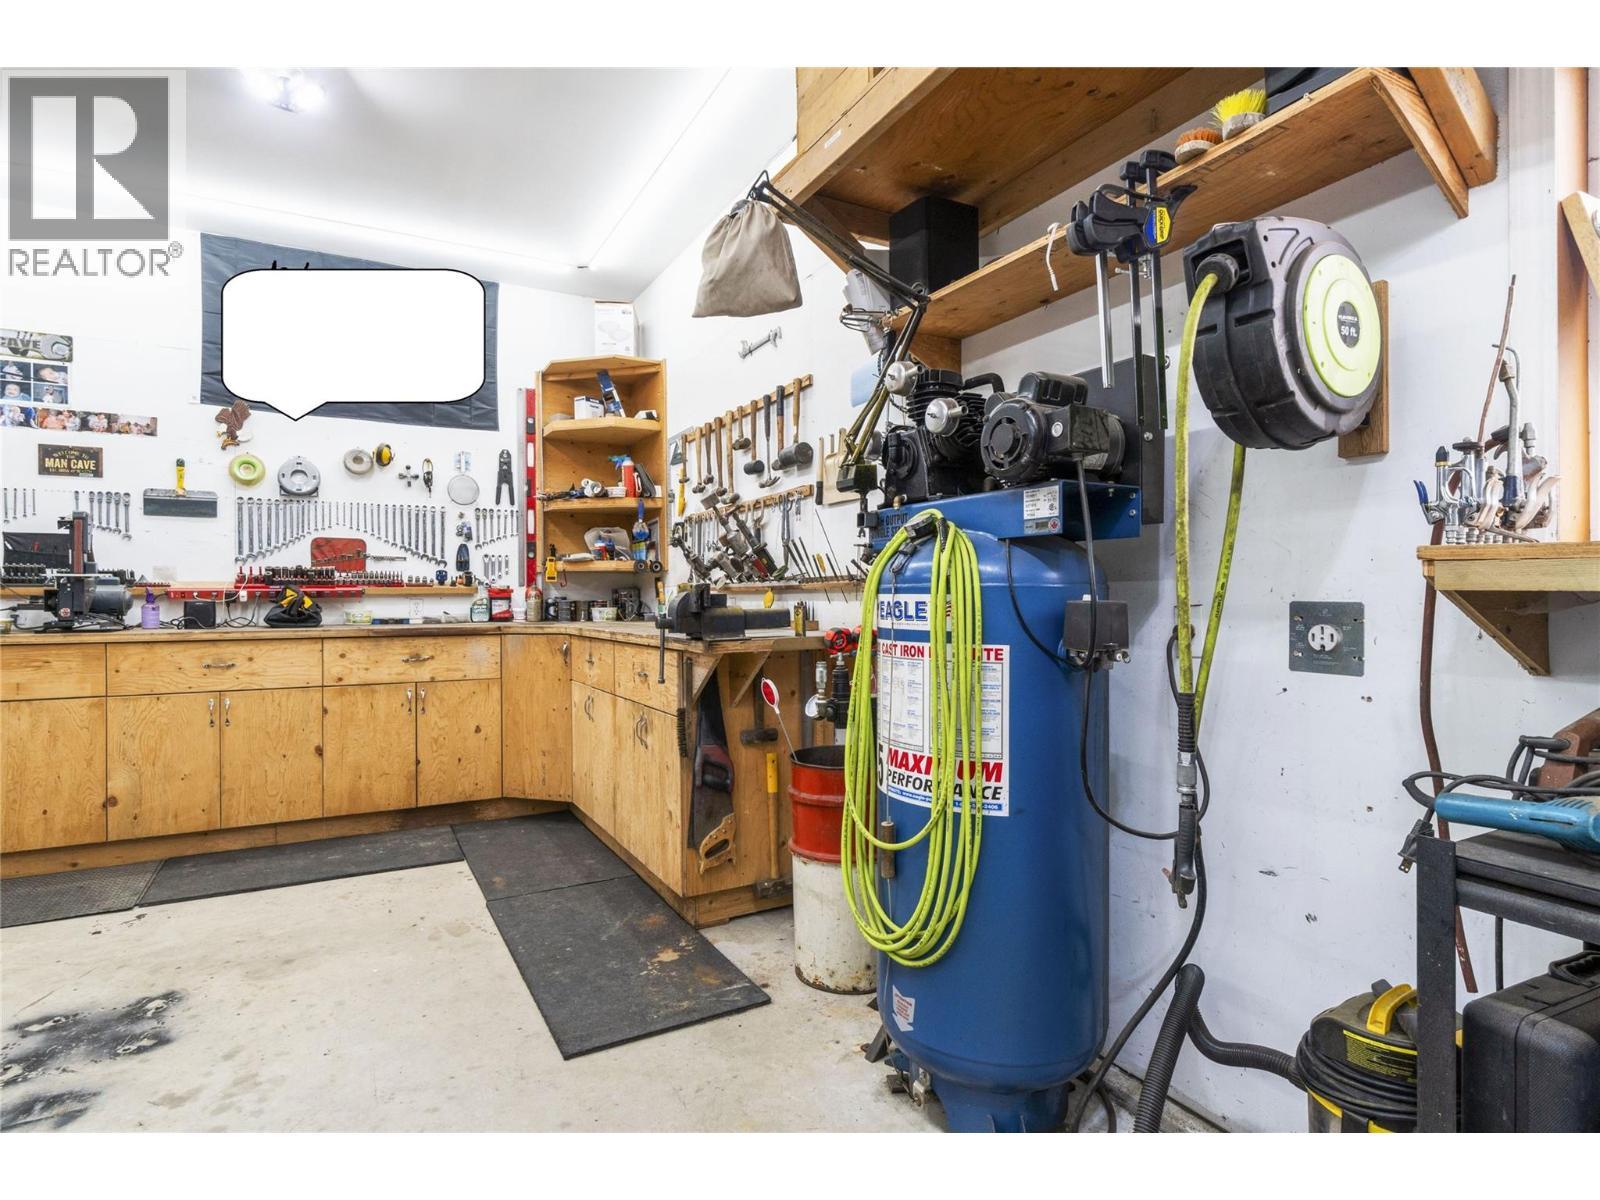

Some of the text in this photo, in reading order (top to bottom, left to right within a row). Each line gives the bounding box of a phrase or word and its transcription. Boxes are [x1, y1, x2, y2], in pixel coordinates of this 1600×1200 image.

[1340, 325, 1349, 336] 50
[45, 457, 68, 469] MAN
[70, 459, 97, 471] CAVE
[885, 512, 908, 526] OUTPUT
[880, 600, 928, 622] EAGLE
[882, 642, 898, 656] CAST
[900, 645, 925, 658] IRON
[888, 747, 1003, 784] MAXIUM
[887, 767, 1003, 800] PERFORACE
